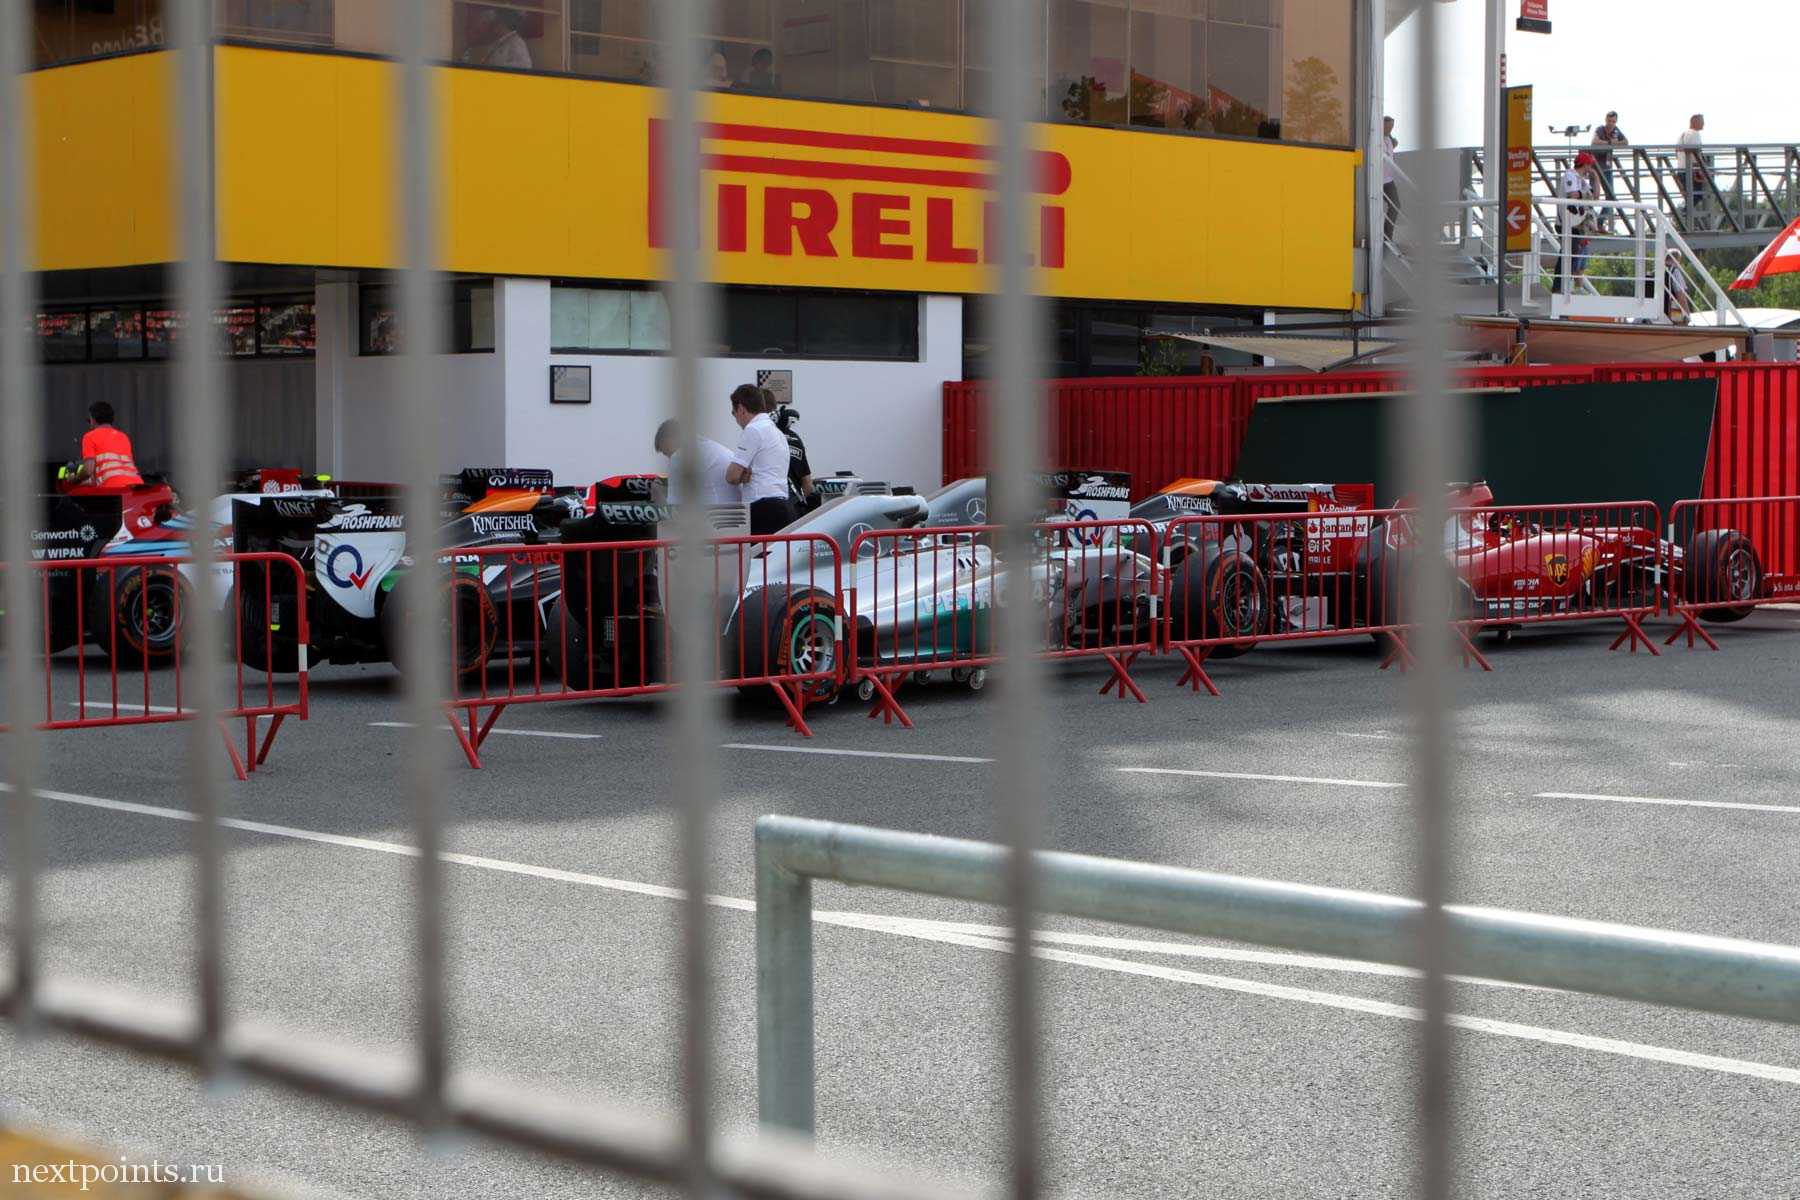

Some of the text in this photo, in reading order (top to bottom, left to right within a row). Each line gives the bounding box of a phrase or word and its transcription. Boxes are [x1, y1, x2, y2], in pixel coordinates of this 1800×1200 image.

[648, 118, 1072, 268] PIRELLI
[1086, 486, 1130, 499] ROSHFRANS
[1167, 495, 1215, 514] KINGFISHER
[341, 515, 404, 530] ROSHFRANS
[470, 513, 538, 535] KINGFISHER
[31, 529, 79, 540] Genworth
[48, 547, 85, 559] WIPAK
